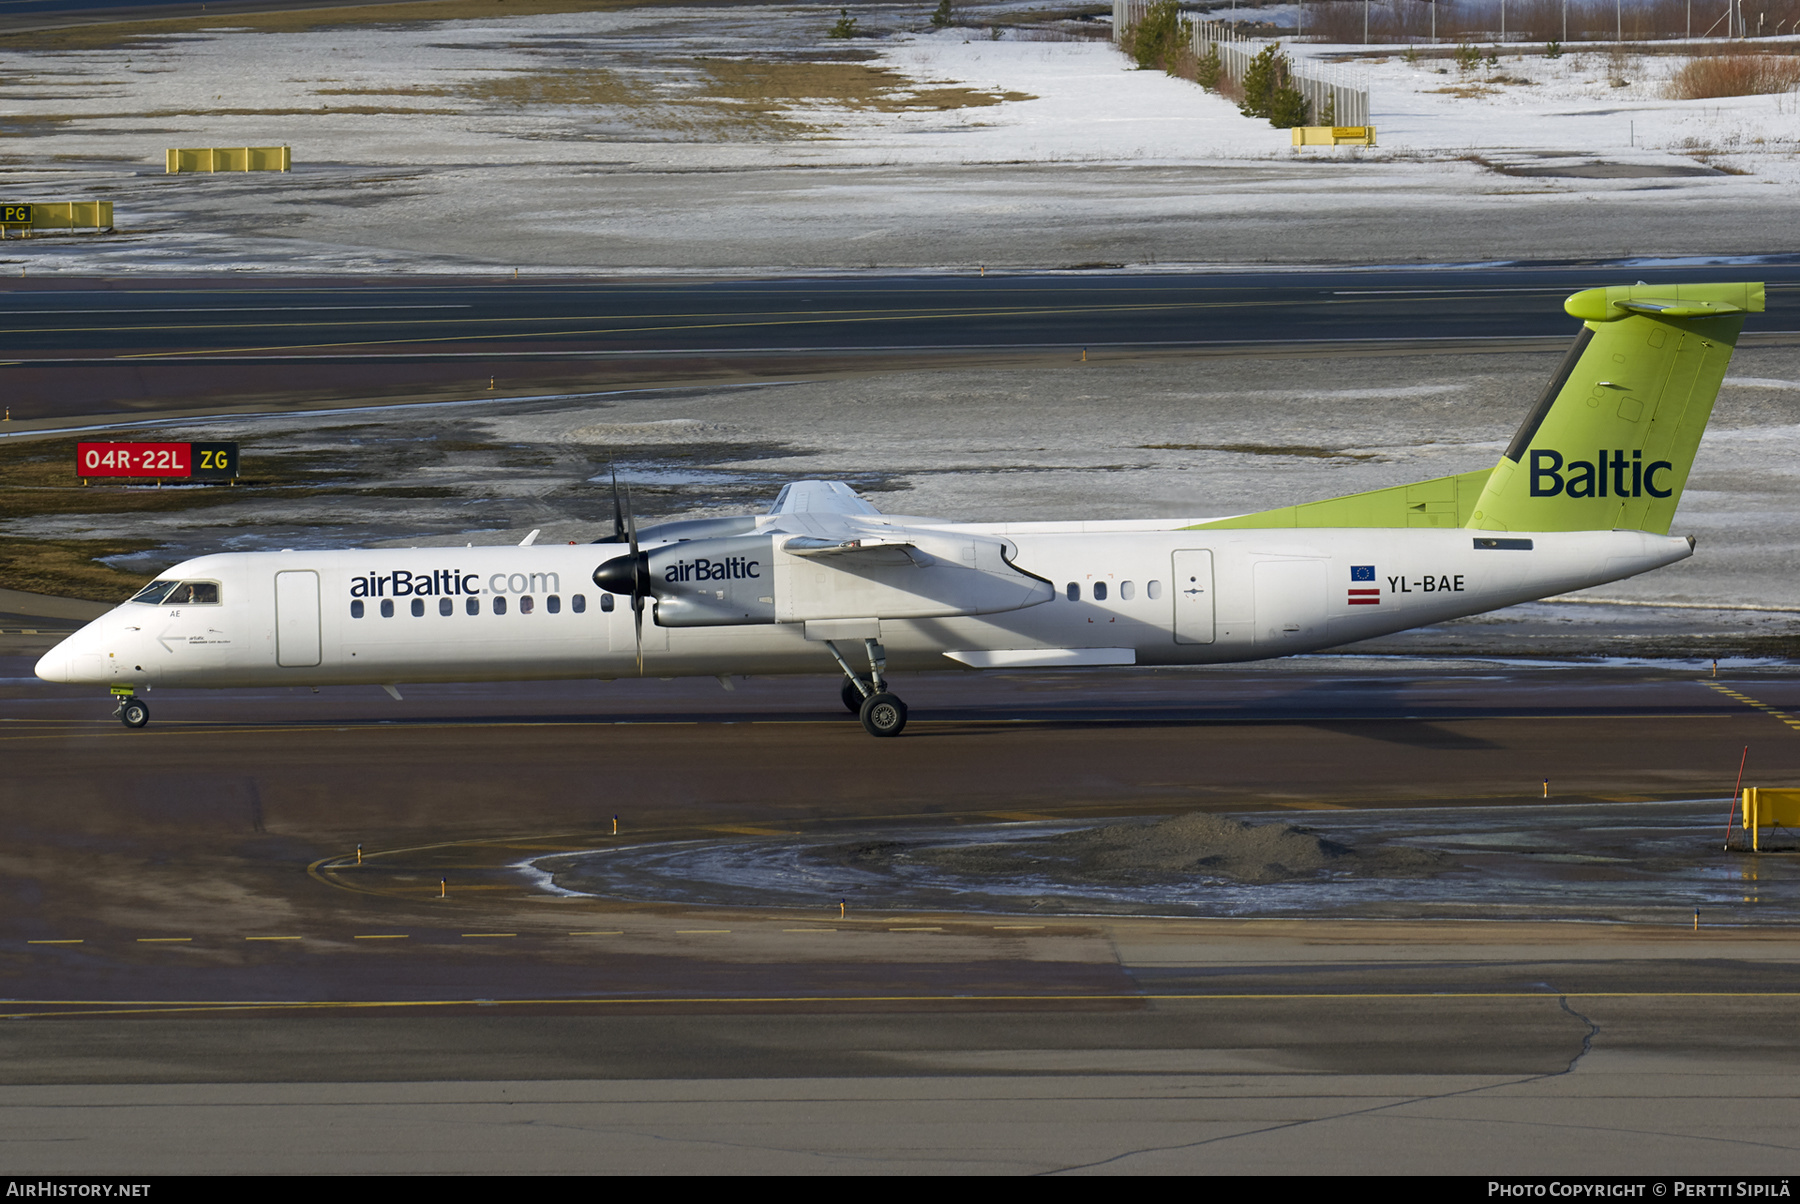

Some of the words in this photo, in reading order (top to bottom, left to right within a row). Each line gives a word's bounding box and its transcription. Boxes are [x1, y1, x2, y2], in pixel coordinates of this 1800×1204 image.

[5, 207, 26, 220] PG
[85, 450, 184, 469] 04R-22L
[200, 450, 228, 469] ZG
[1530, 449, 1672, 498] Baltic
[664, 556, 760, 583] airBaltic
[350, 569, 560, 597] airBaltic.com
[1387, 575, 1465, 593] YL-BAE
[169, 609, 181, 618] AE
